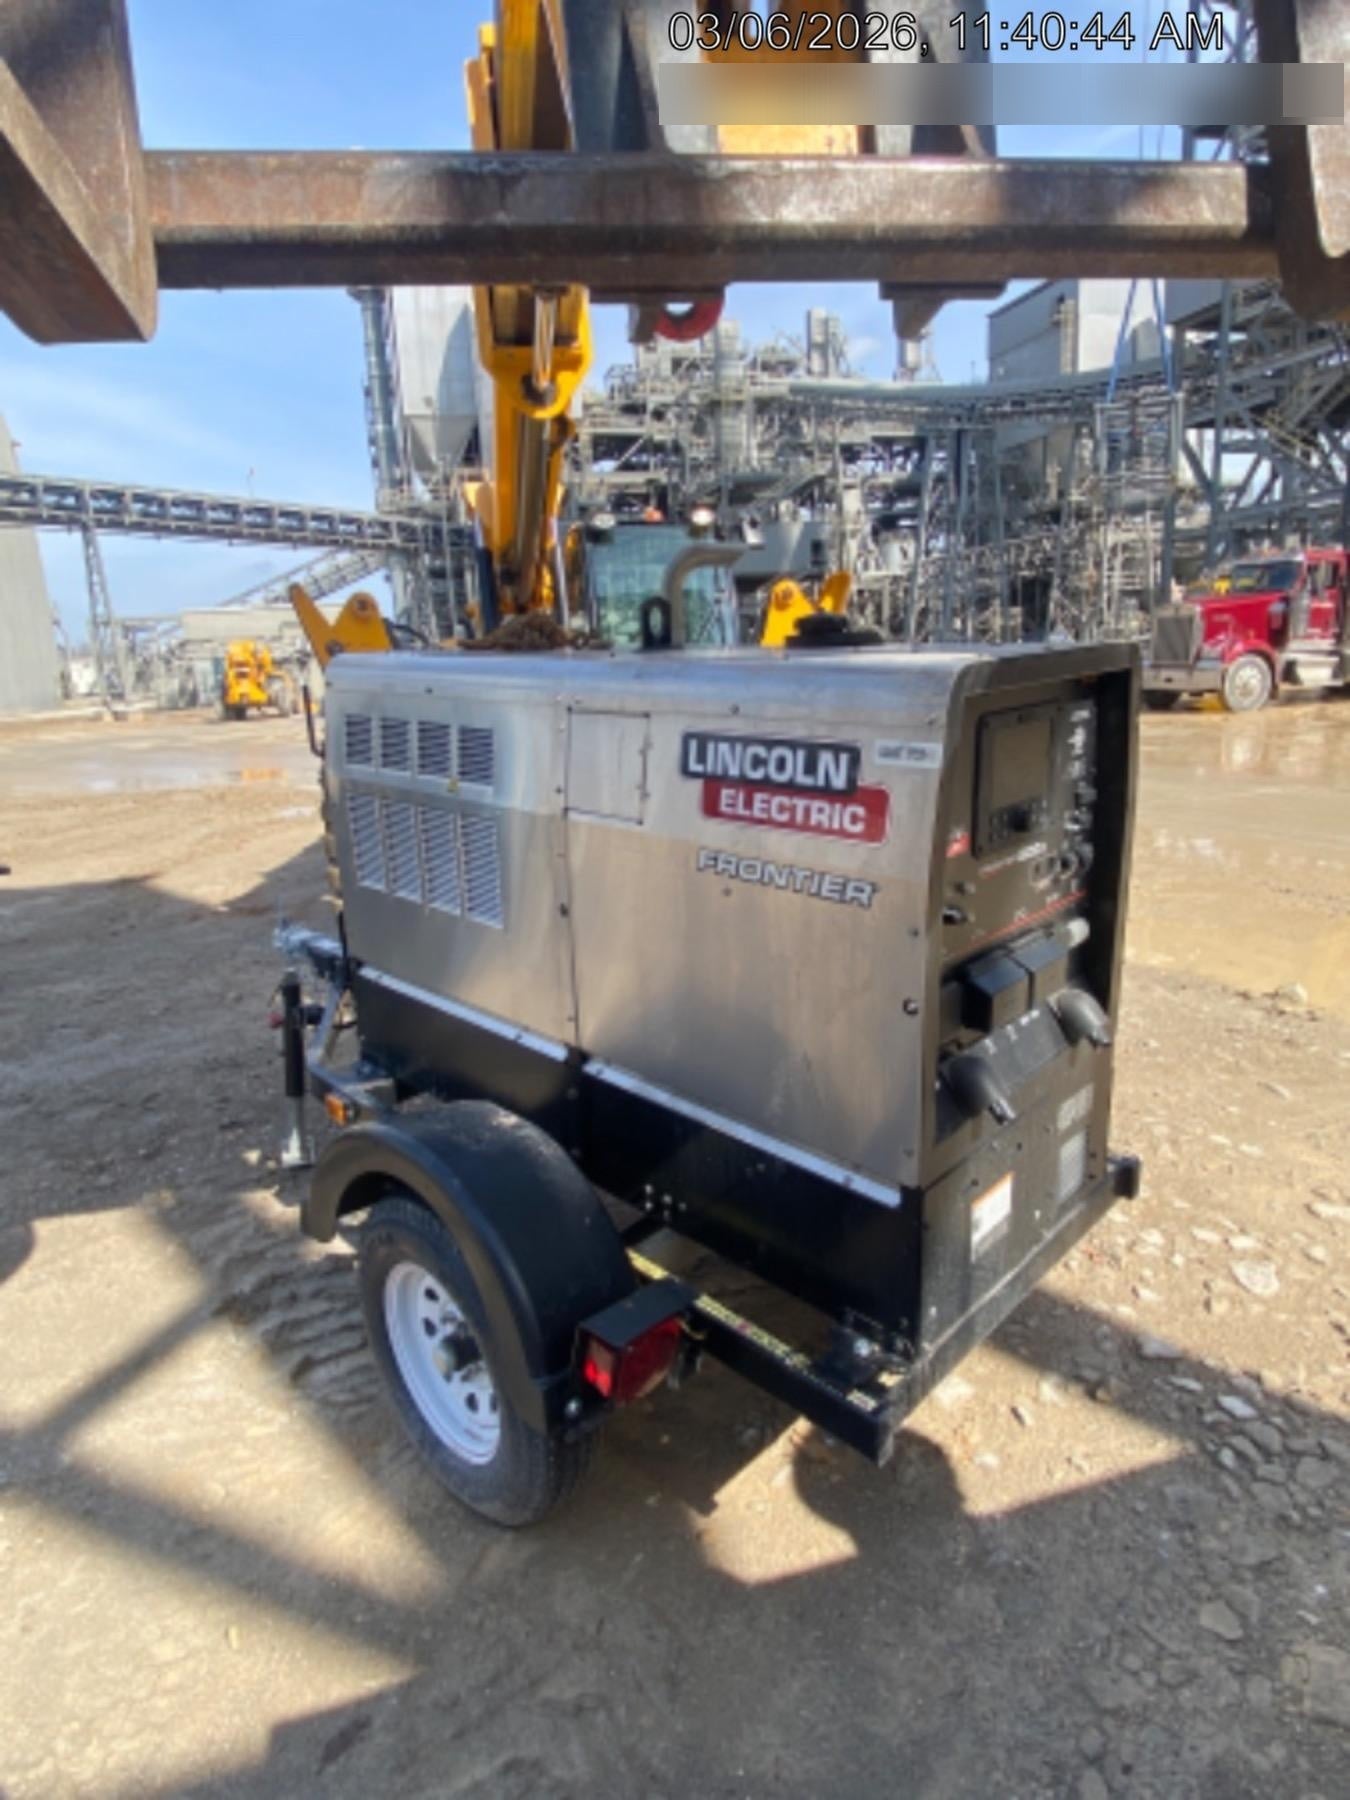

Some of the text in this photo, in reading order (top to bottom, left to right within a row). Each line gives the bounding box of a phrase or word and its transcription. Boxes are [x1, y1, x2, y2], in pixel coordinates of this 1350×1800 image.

[687, 738, 850, 790] LINCOLN
[719, 787, 867, 834] ELECTRIC
[697, 849, 876, 908] FRONTIER
